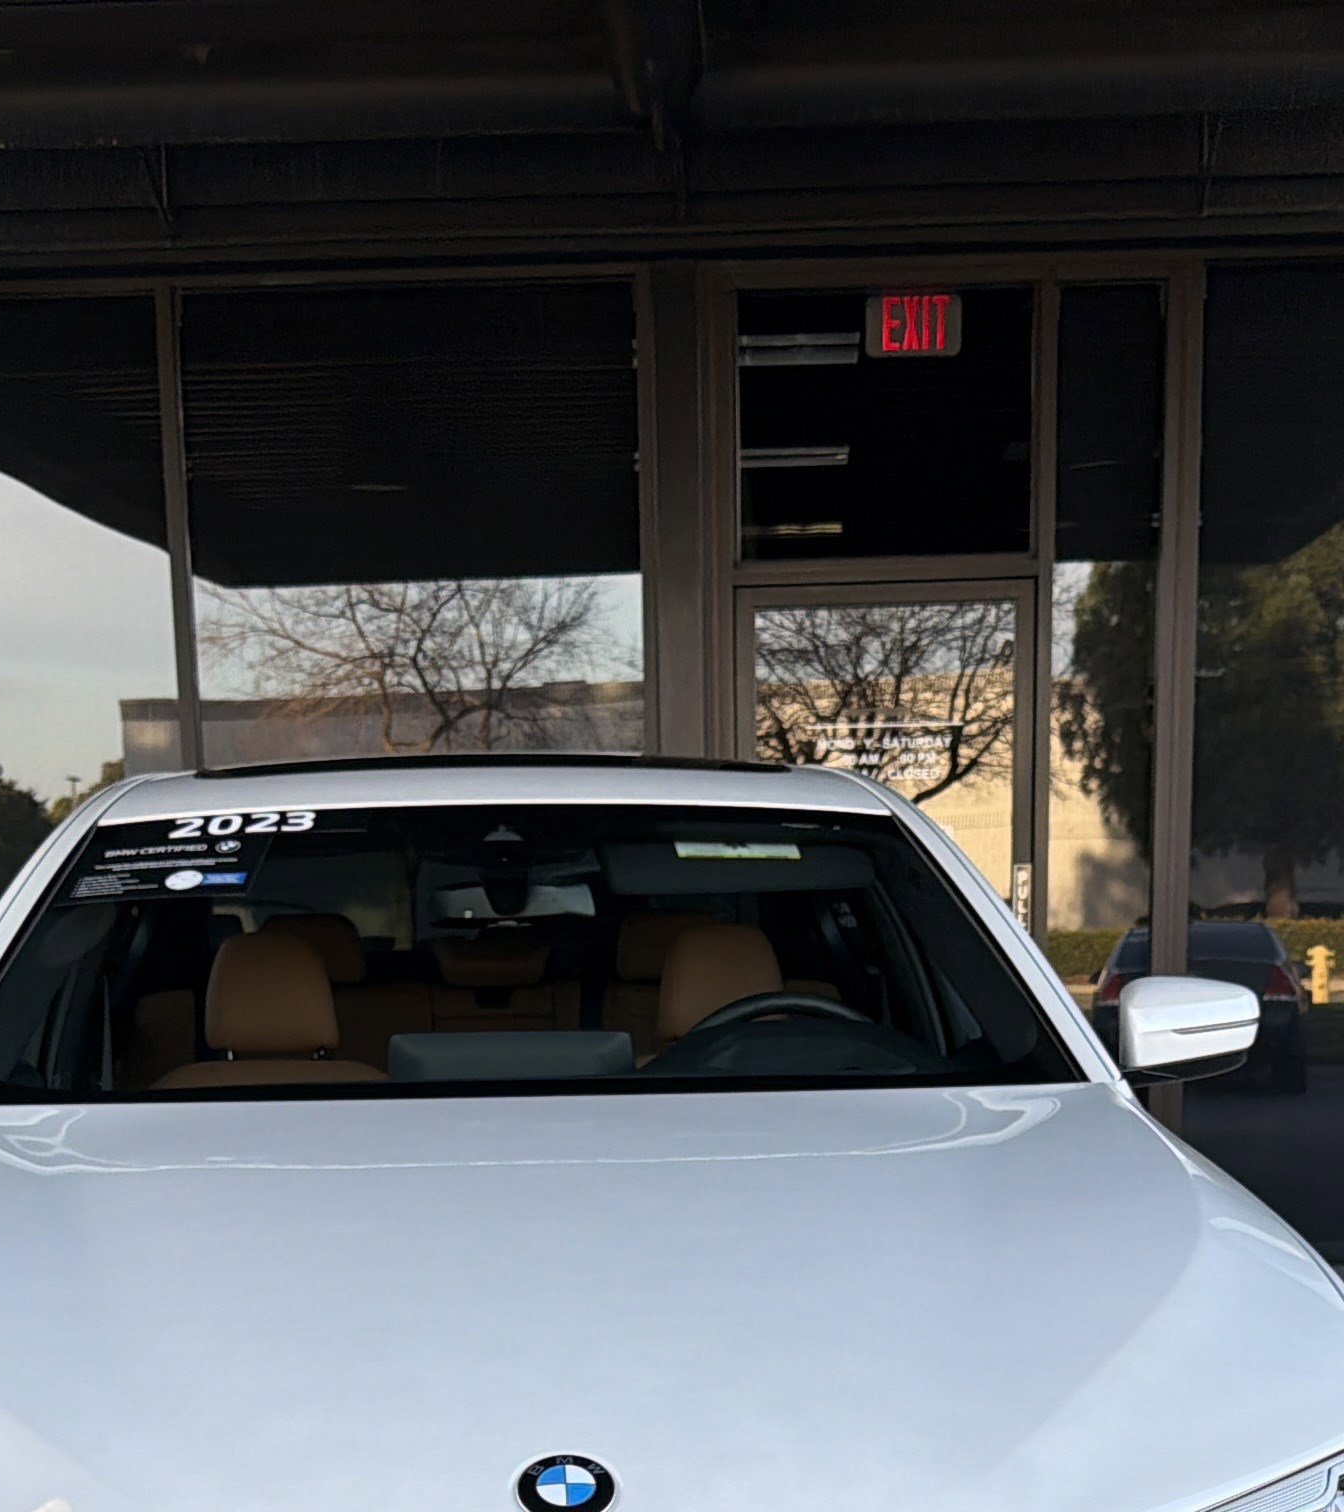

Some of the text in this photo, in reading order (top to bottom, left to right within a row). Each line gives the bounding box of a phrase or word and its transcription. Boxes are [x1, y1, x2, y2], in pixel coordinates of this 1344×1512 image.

[882, 295, 950, 352] EXIT
[816, 737, 873, 751] MONDY
[167, 811, 317, 840] 2023
[526, 1456, 606, 1476] BMW
